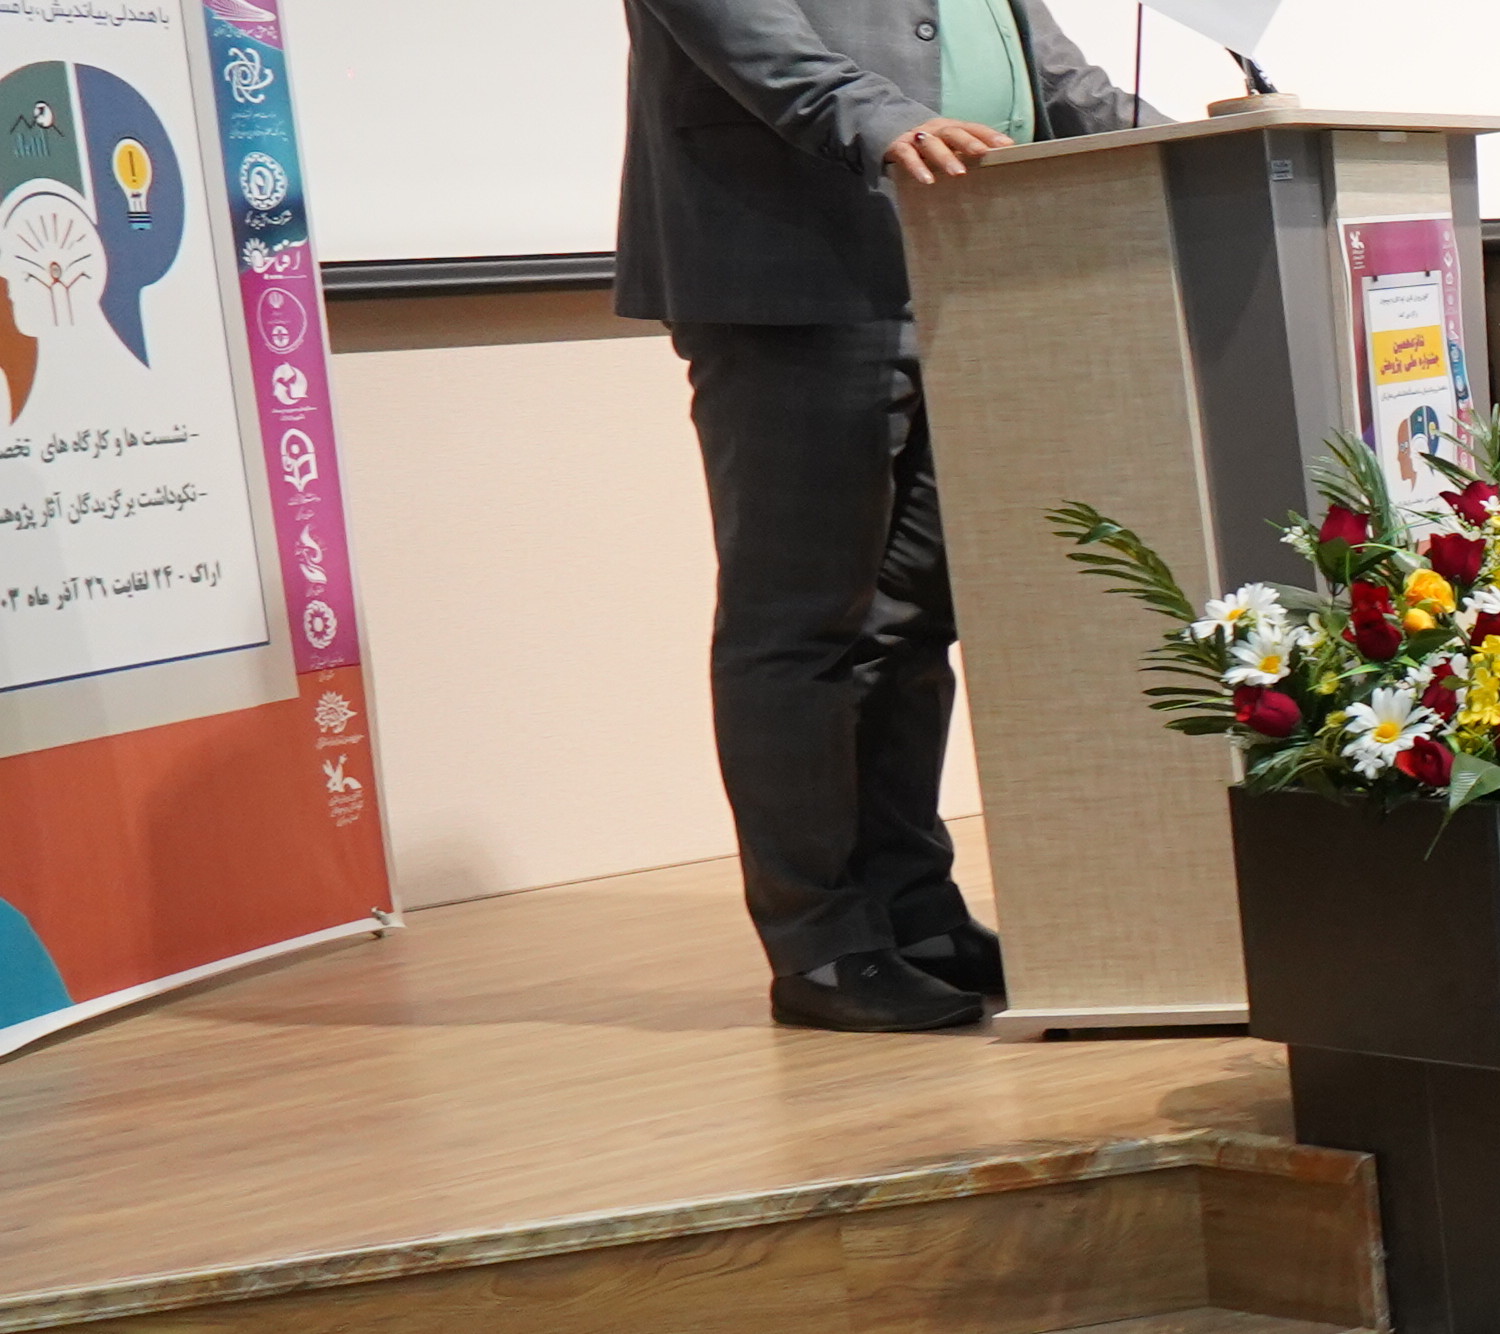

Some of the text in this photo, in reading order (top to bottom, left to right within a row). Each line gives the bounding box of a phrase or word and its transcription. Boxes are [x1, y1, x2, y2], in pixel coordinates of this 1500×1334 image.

[41, 433, 69, 464] های
[115, 438, 123, 457] و
[40, 492, 62, 528] آثار
[190, 561, 222, 588] اراک
[28, 585, 50, 608] ماه
[57, 576, 78, 611] آذر
